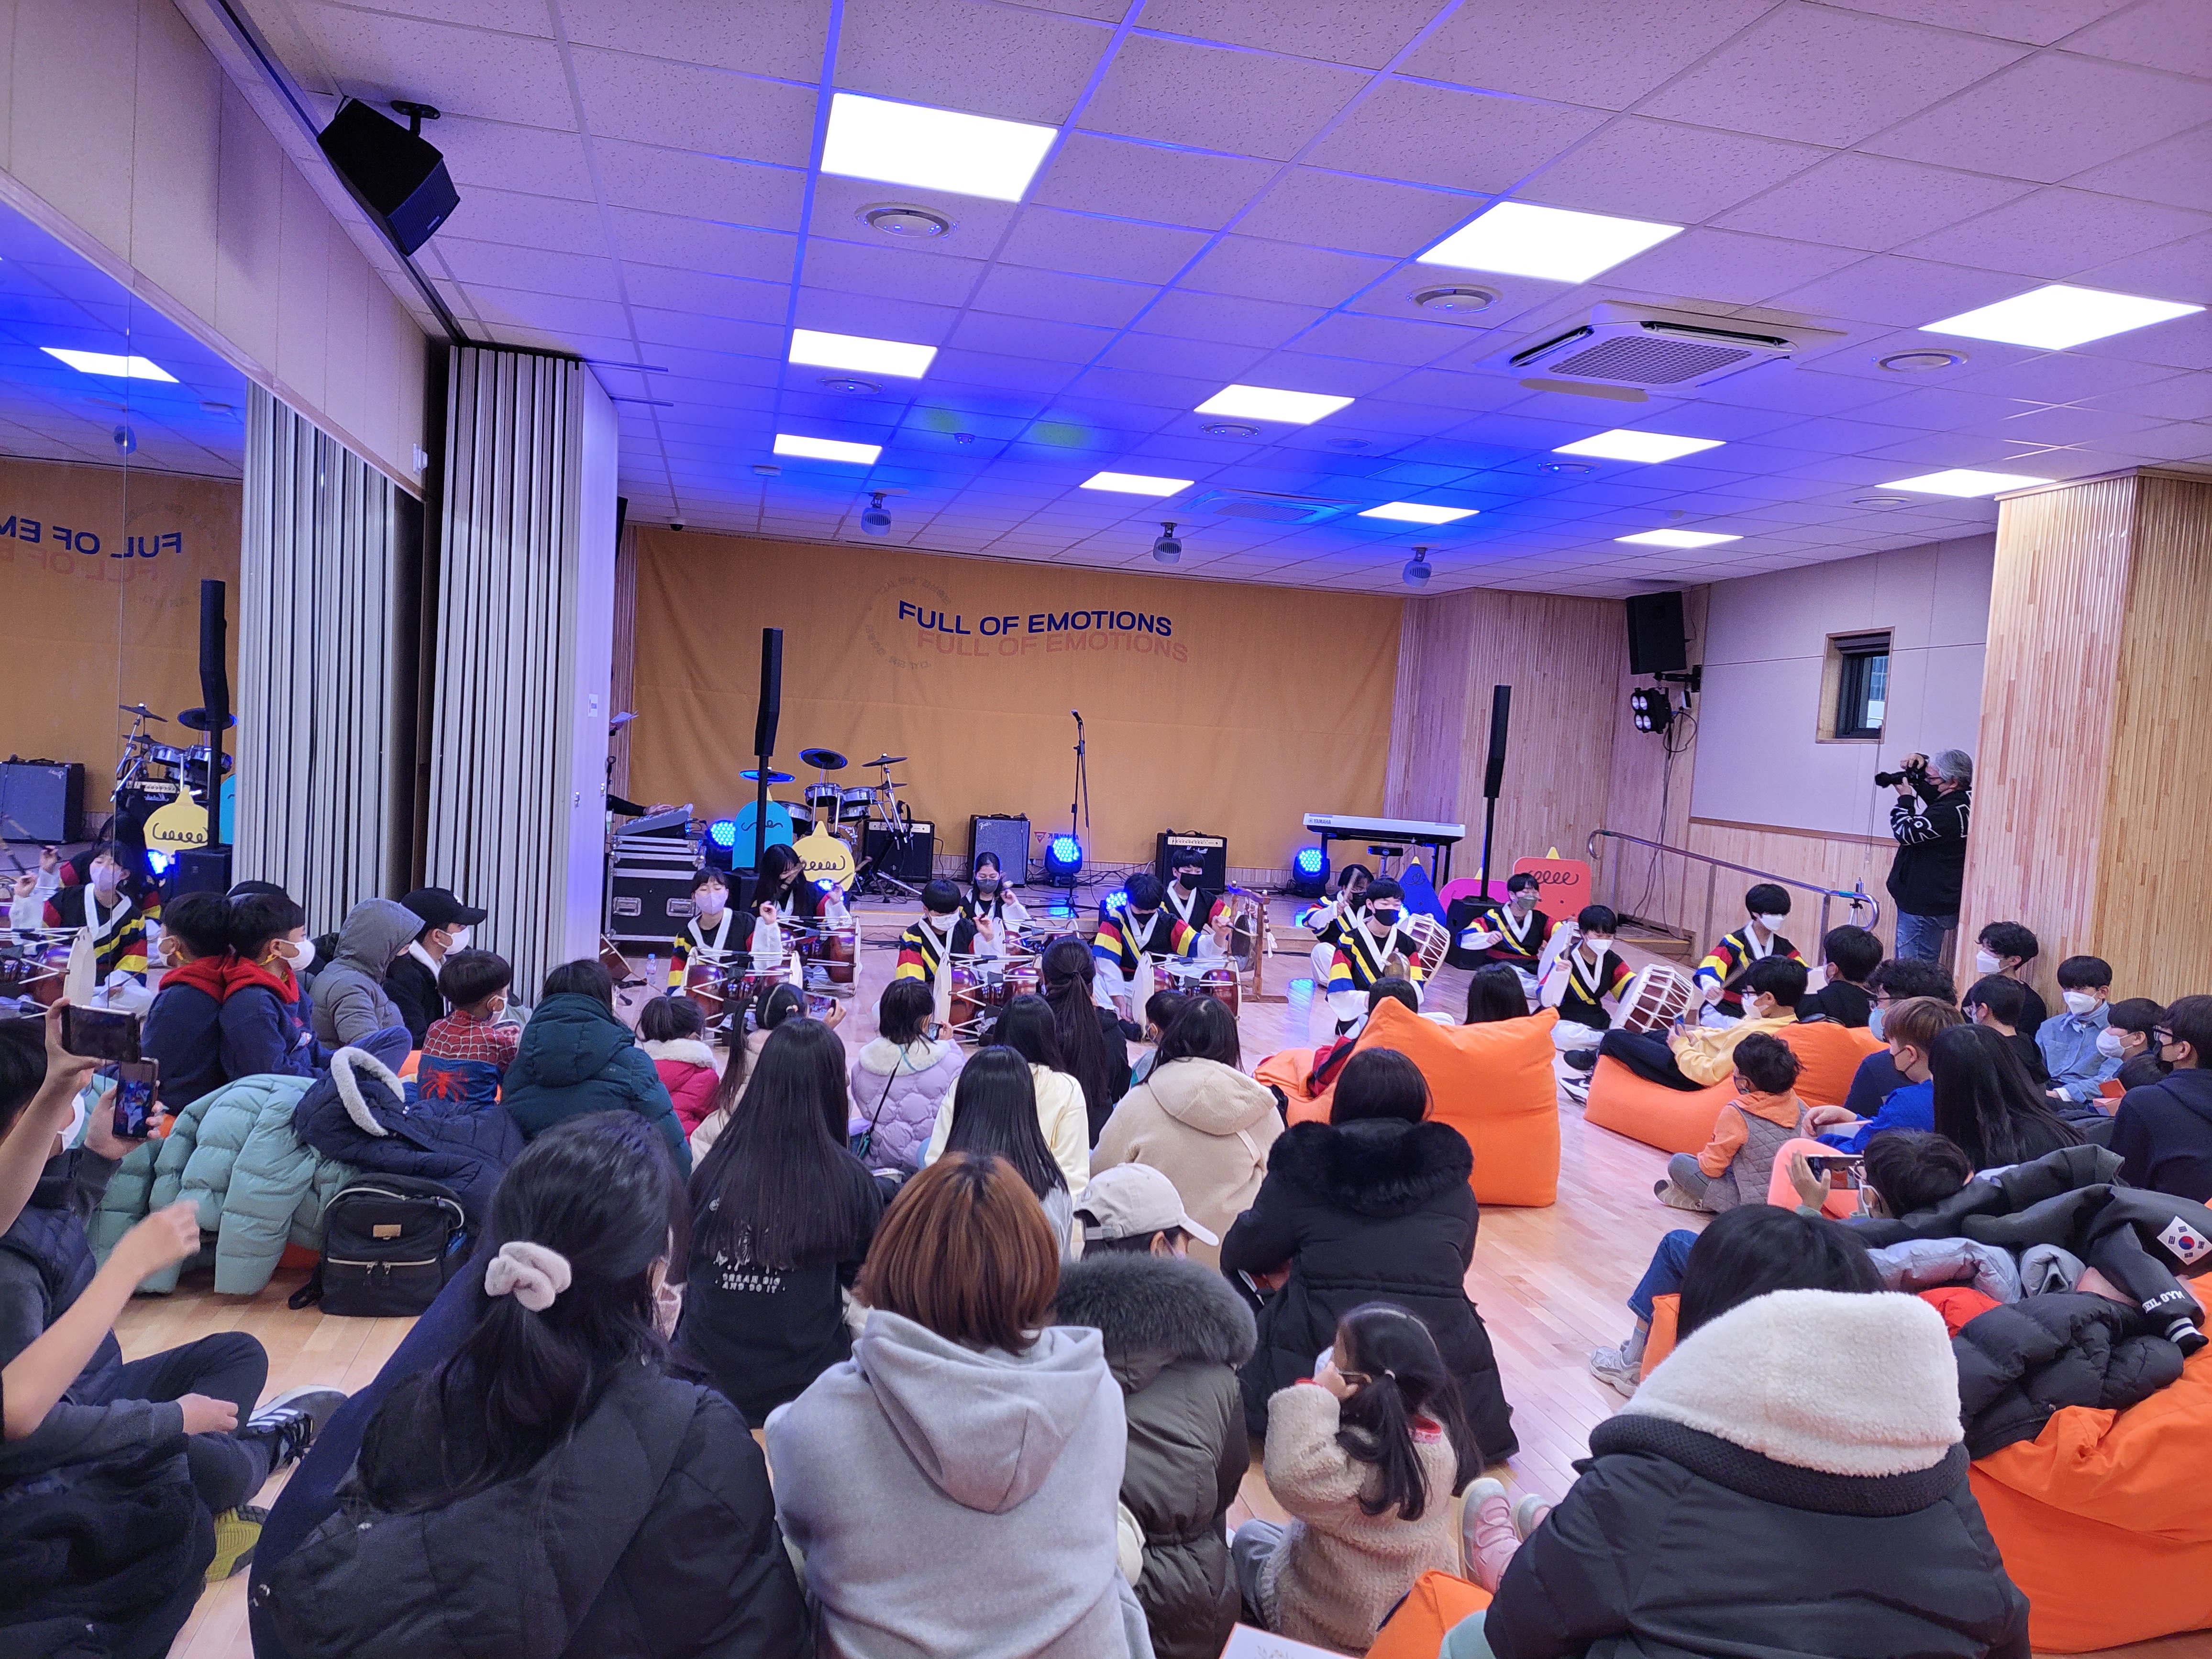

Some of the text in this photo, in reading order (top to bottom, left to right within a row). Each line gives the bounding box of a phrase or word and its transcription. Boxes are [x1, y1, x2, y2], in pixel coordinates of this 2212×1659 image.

[898, 600, 1172, 637] FULL OF EMOTIONS
[918, 630, 1188, 663] FULL OF EMOTIONS
